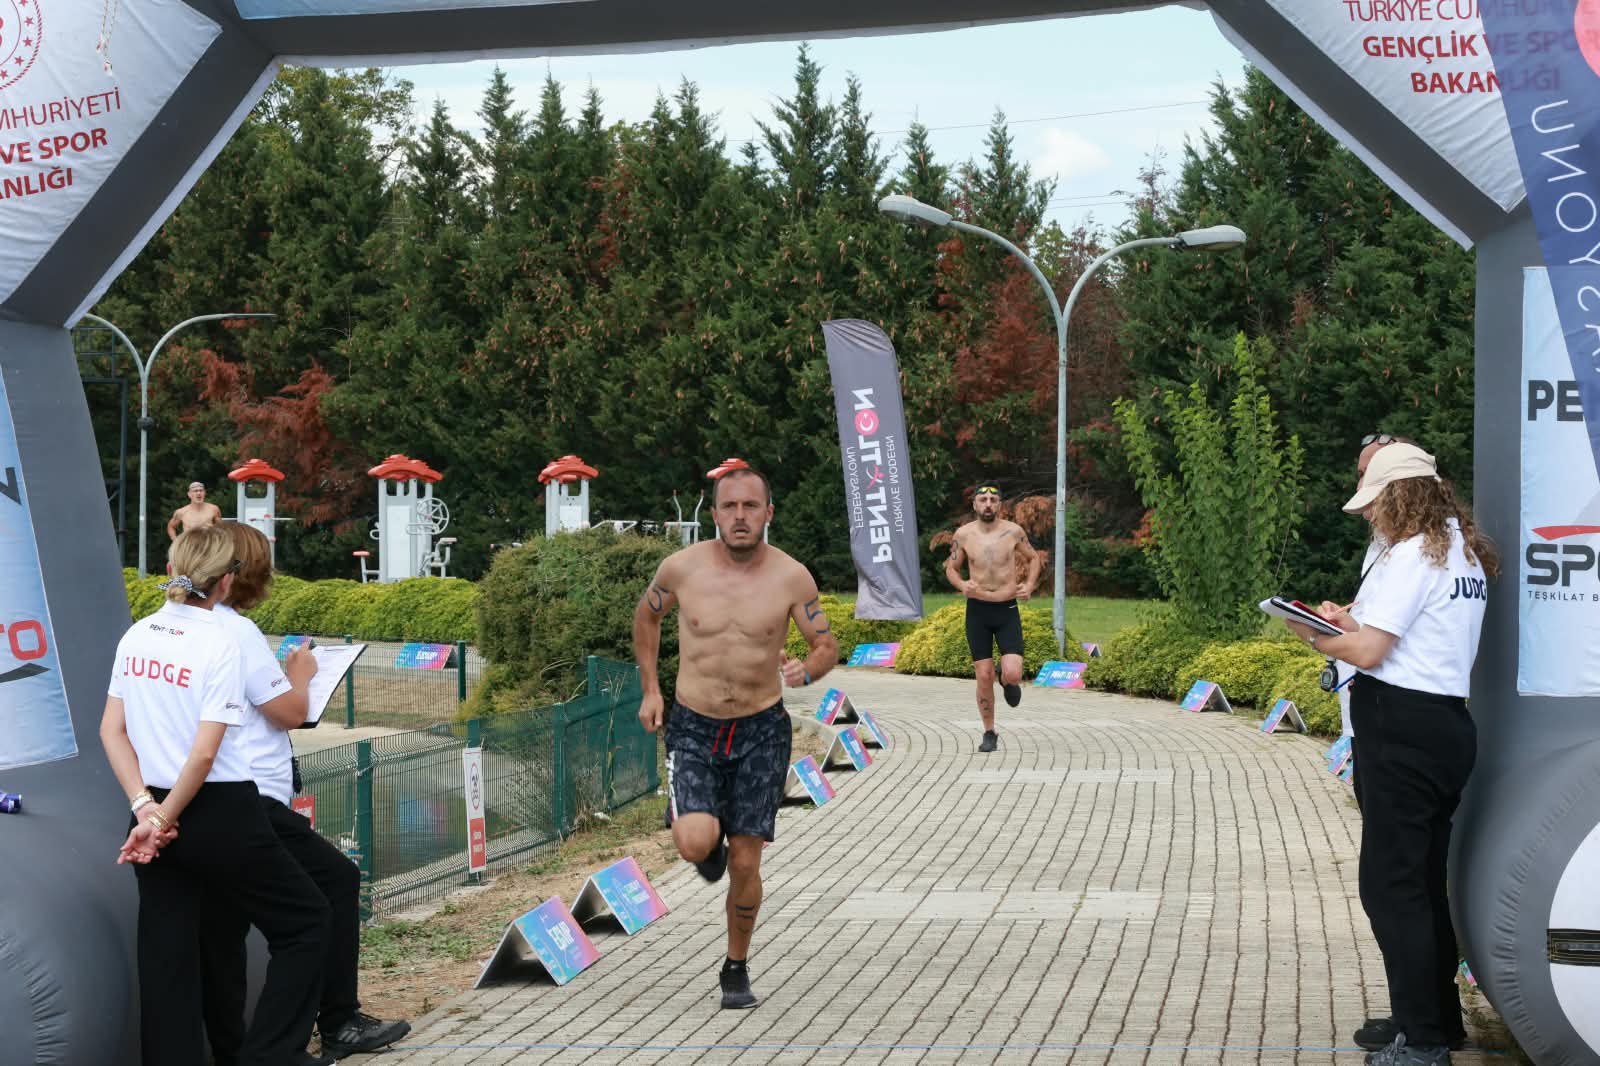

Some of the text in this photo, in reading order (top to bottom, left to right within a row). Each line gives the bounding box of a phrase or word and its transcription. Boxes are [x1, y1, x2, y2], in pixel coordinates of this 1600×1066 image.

[1363, 30, 1479, 64] GENÇLİK
[0, 127, 108, 165] VE SPOR
[123, 655, 193, 689] JUDGE
